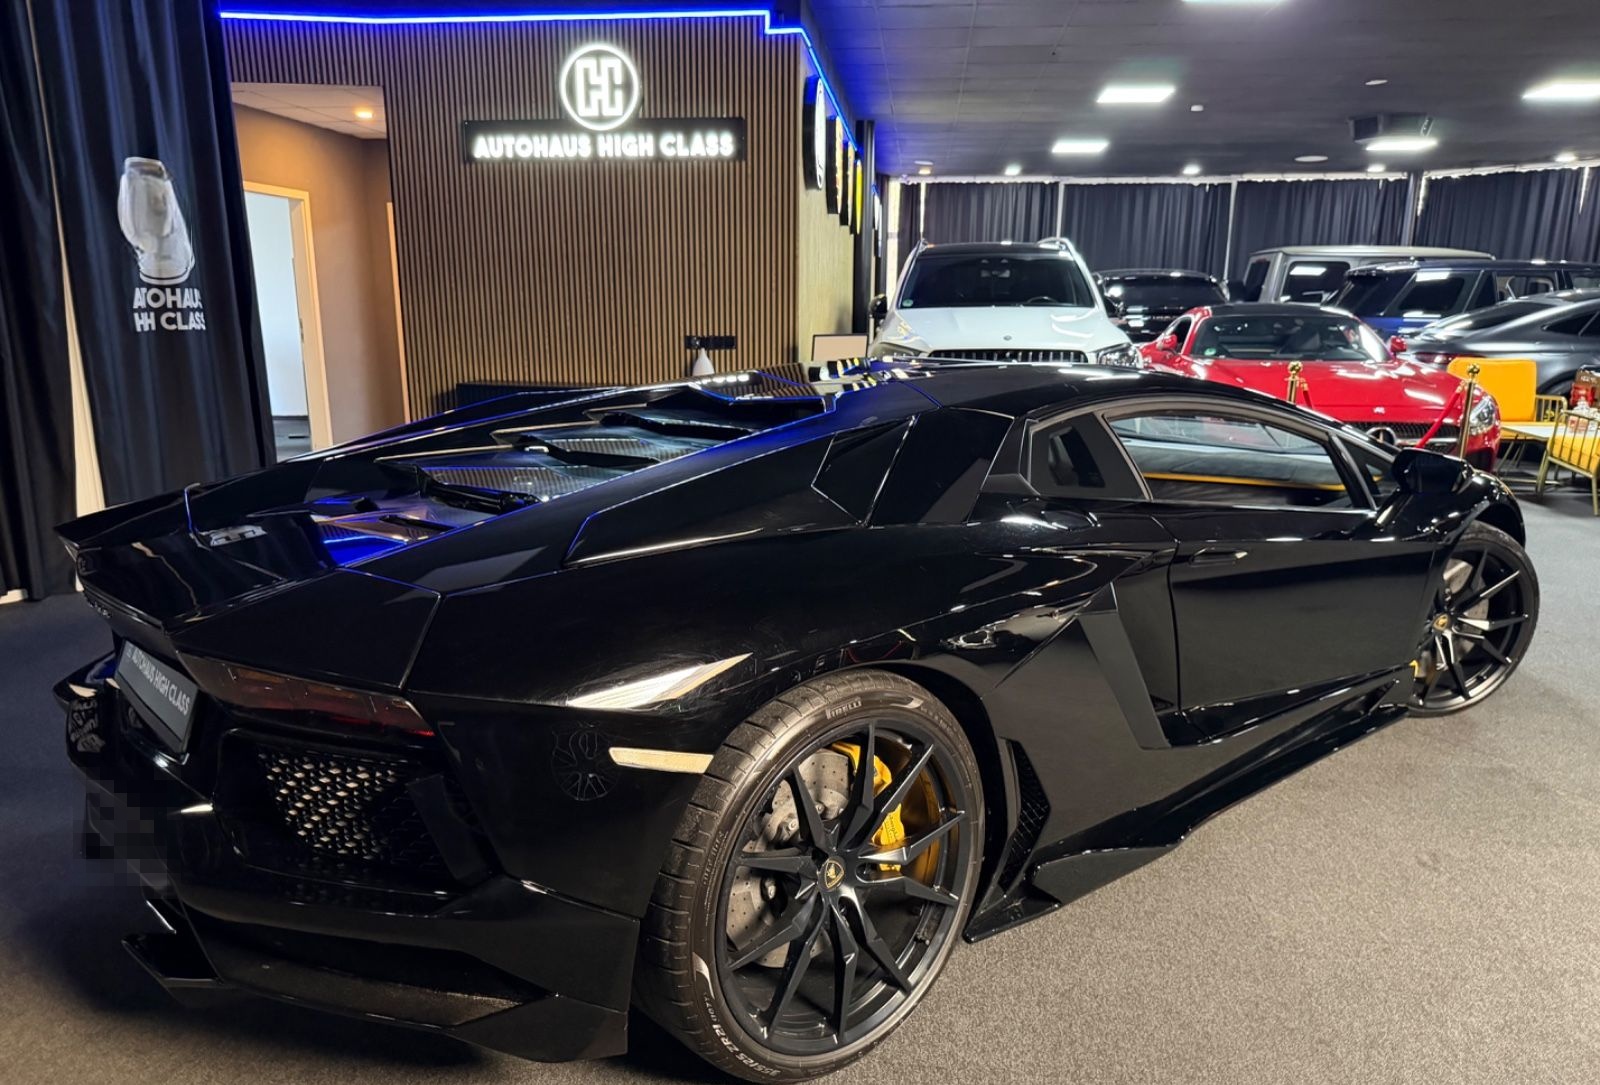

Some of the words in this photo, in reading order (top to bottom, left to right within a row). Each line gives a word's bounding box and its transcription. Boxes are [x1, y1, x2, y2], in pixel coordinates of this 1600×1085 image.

[473, 134, 592, 158] AUTOHAUS
[597, 132, 654, 158] HIGH
[659, 132, 734, 157] CLASS
[132, 648, 155, 683] AUTOHAUS
[153, 668, 170, 697] HIGH
[168, 684, 191, 716] CLASS
[825, 698, 862, 719] PIRELLI
